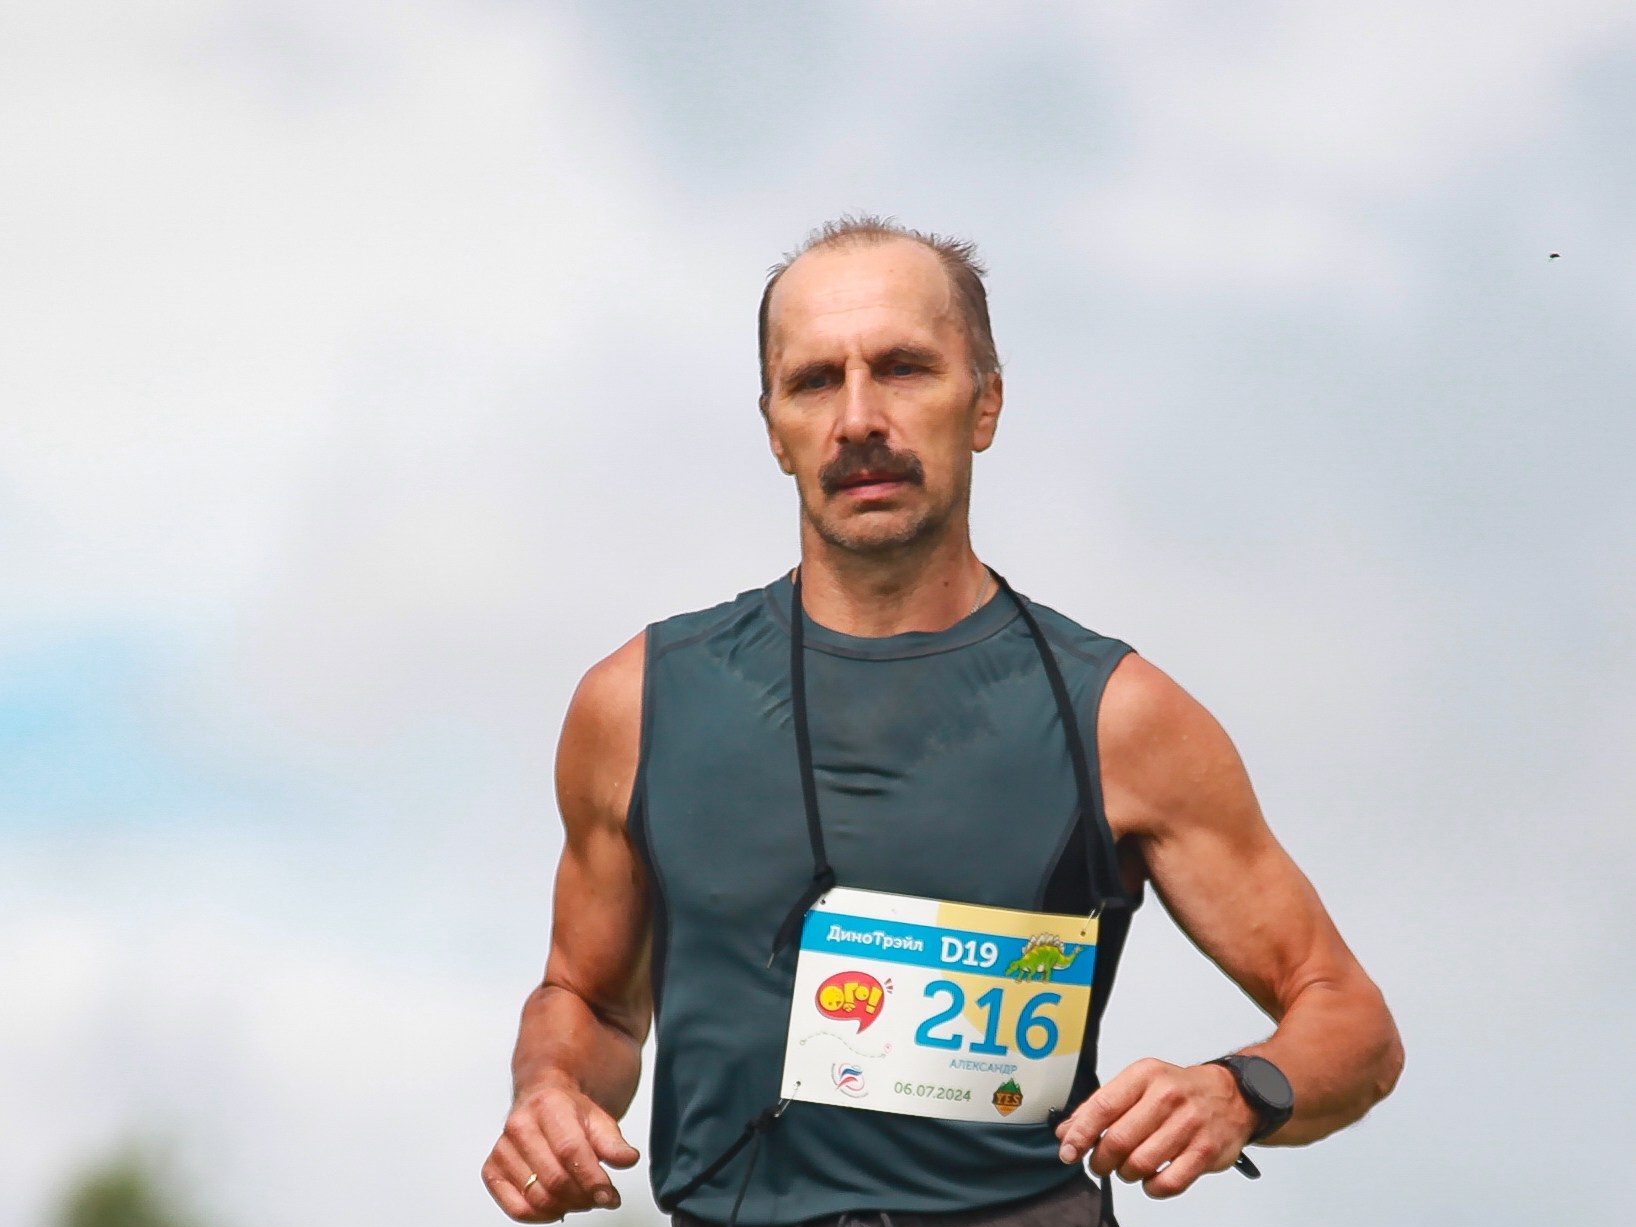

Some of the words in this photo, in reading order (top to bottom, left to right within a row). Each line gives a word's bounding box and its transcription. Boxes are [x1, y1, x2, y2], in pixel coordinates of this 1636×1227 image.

[826, 925, 924, 952] ДиноТрэйл
[940, 936, 999, 968] D19
[914, 979, 1062, 1060] 216
[949, 1059, 1018, 1074] АЛЕКСАНДР
[894, 1082, 972, 1102] 06.07.2024
[996, 1092, 1021, 1106] YES
